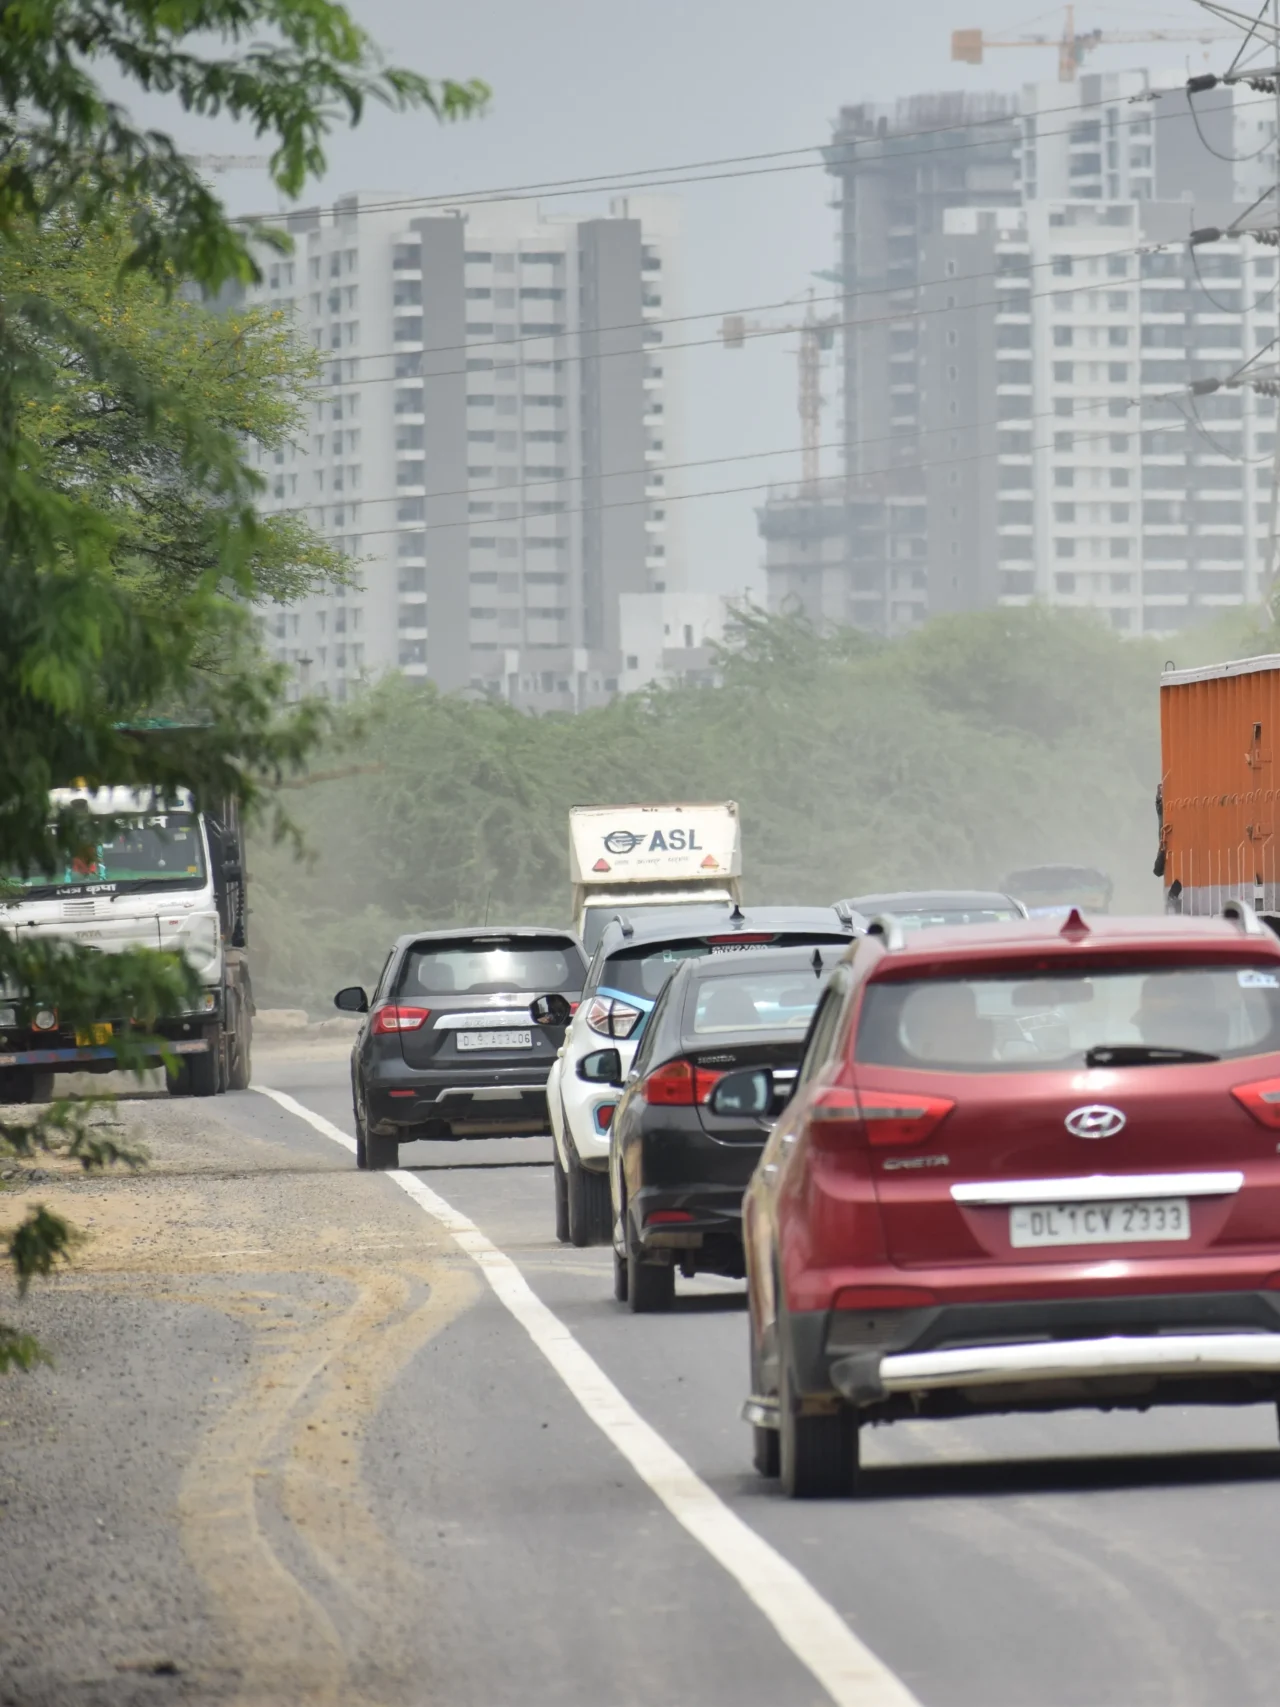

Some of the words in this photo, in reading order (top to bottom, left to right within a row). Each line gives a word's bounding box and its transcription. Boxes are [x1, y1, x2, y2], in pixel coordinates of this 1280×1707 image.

[648, 829, 703, 852] ASL
[74, 929, 102, 939] TATA
[1030, 1210, 1060, 1236] DL
